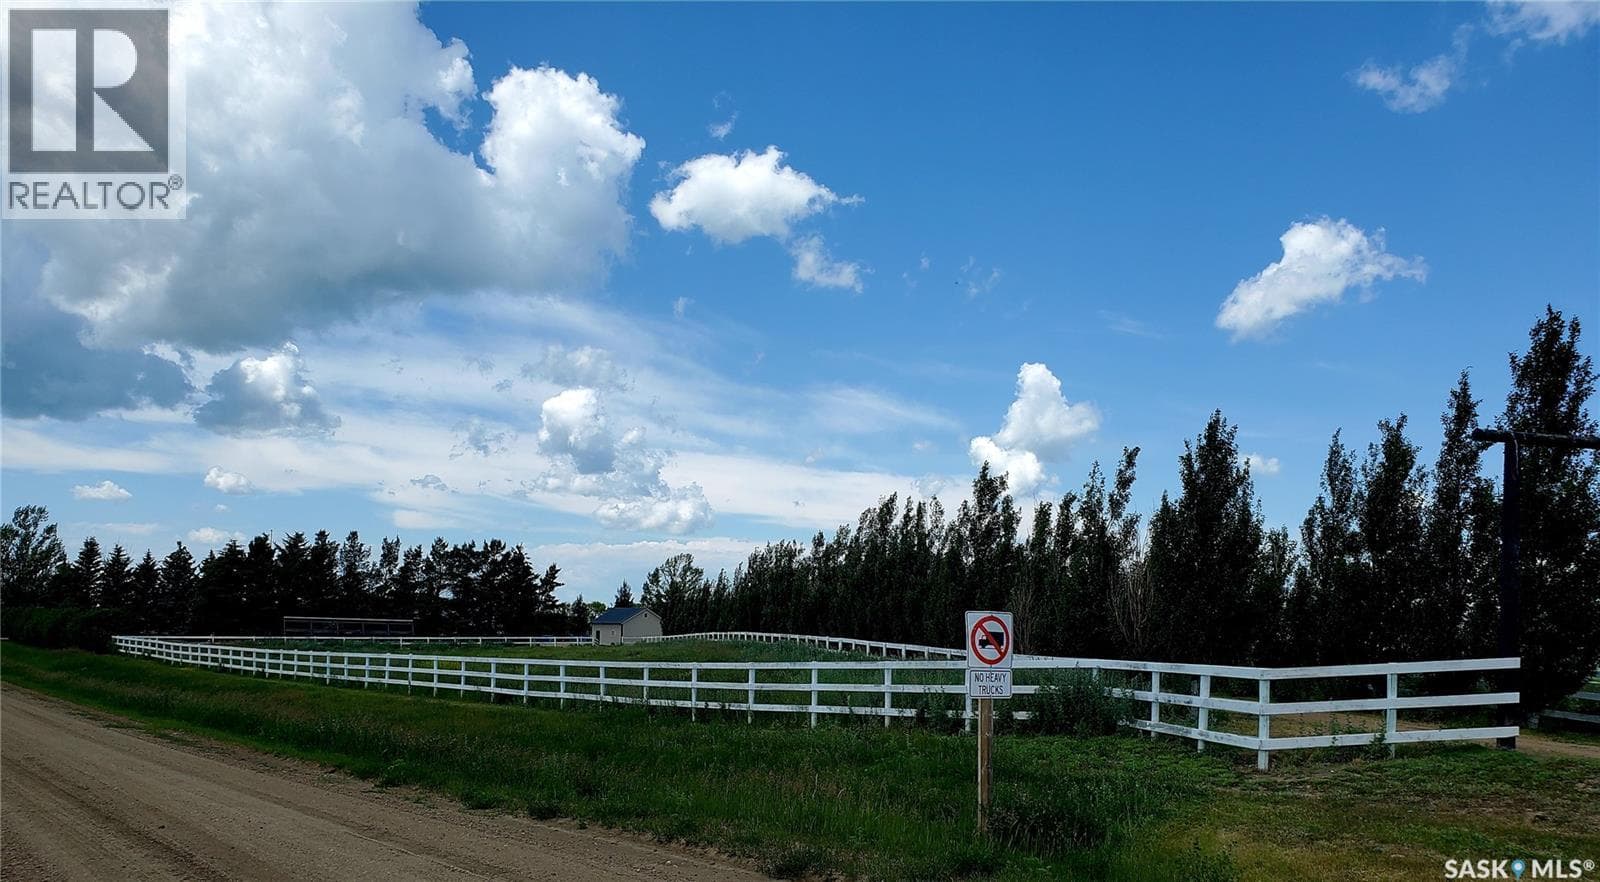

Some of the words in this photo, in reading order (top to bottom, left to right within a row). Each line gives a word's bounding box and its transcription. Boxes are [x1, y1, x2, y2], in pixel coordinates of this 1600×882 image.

[974, 672, 984, 682] NO
[986, 672, 1006, 682] HEAVY
[978, 685, 1004, 694] TRUCKS
